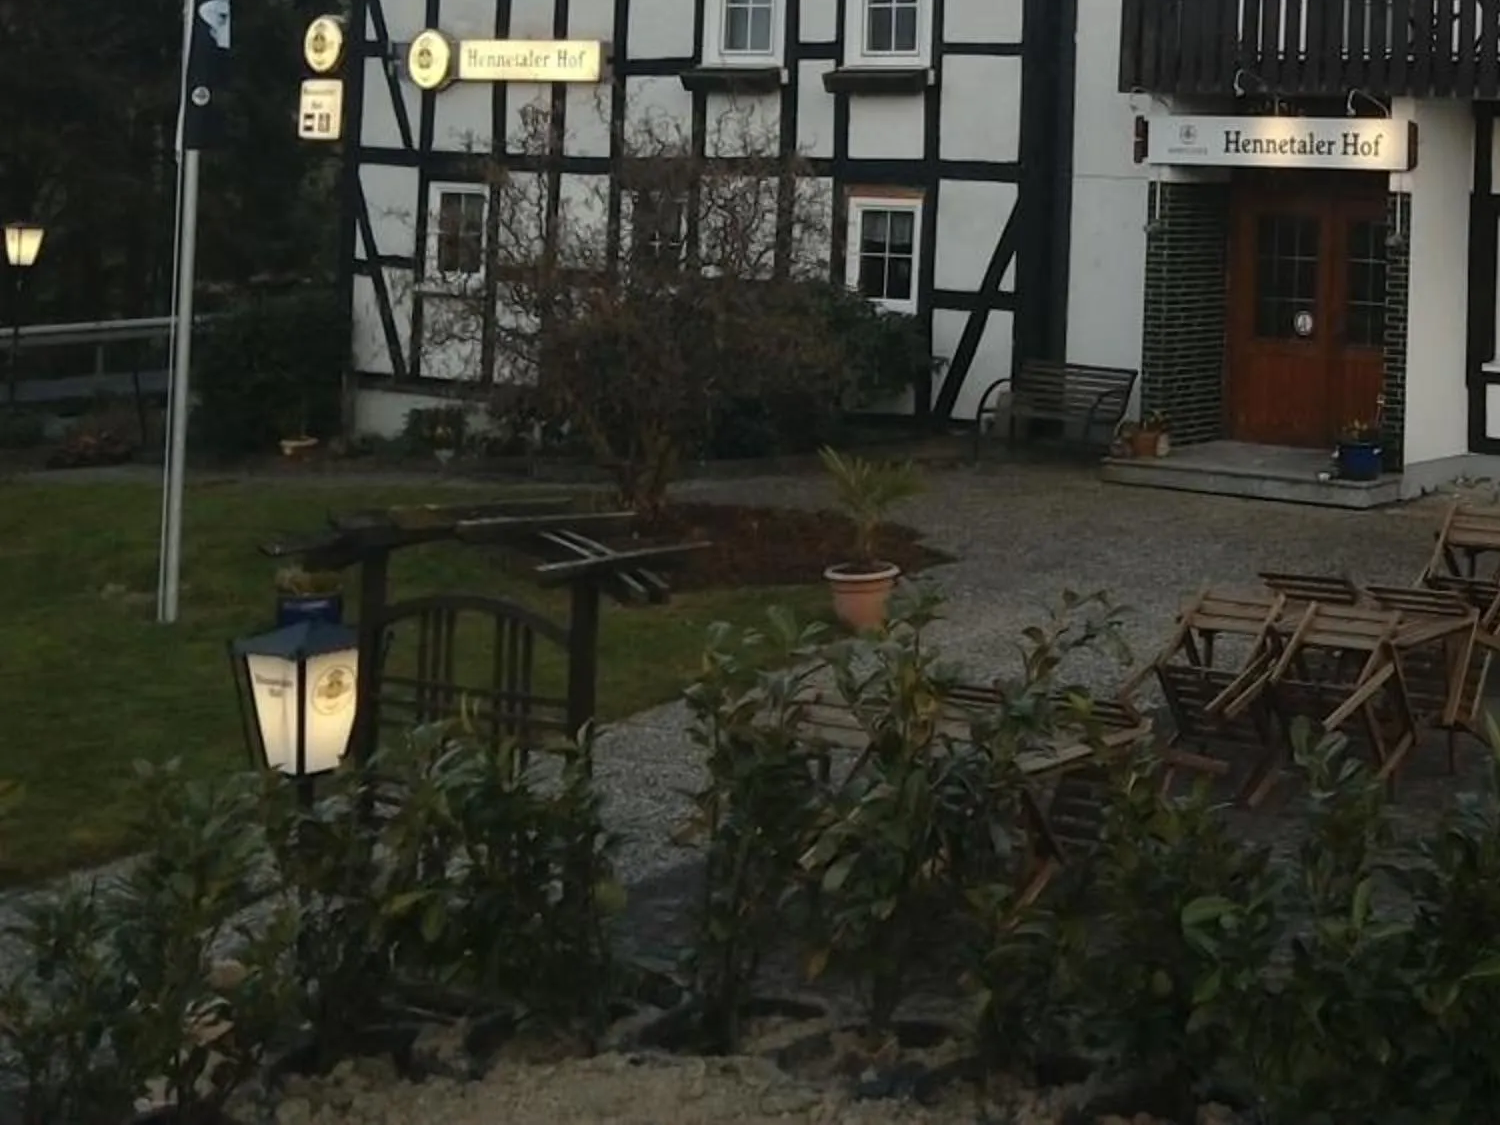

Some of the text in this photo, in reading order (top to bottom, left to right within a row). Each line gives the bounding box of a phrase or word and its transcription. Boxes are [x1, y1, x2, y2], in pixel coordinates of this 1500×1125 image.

[556, 48, 587, 68] Hof
[1223, 130, 1383, 157] Hennetaler Hof
